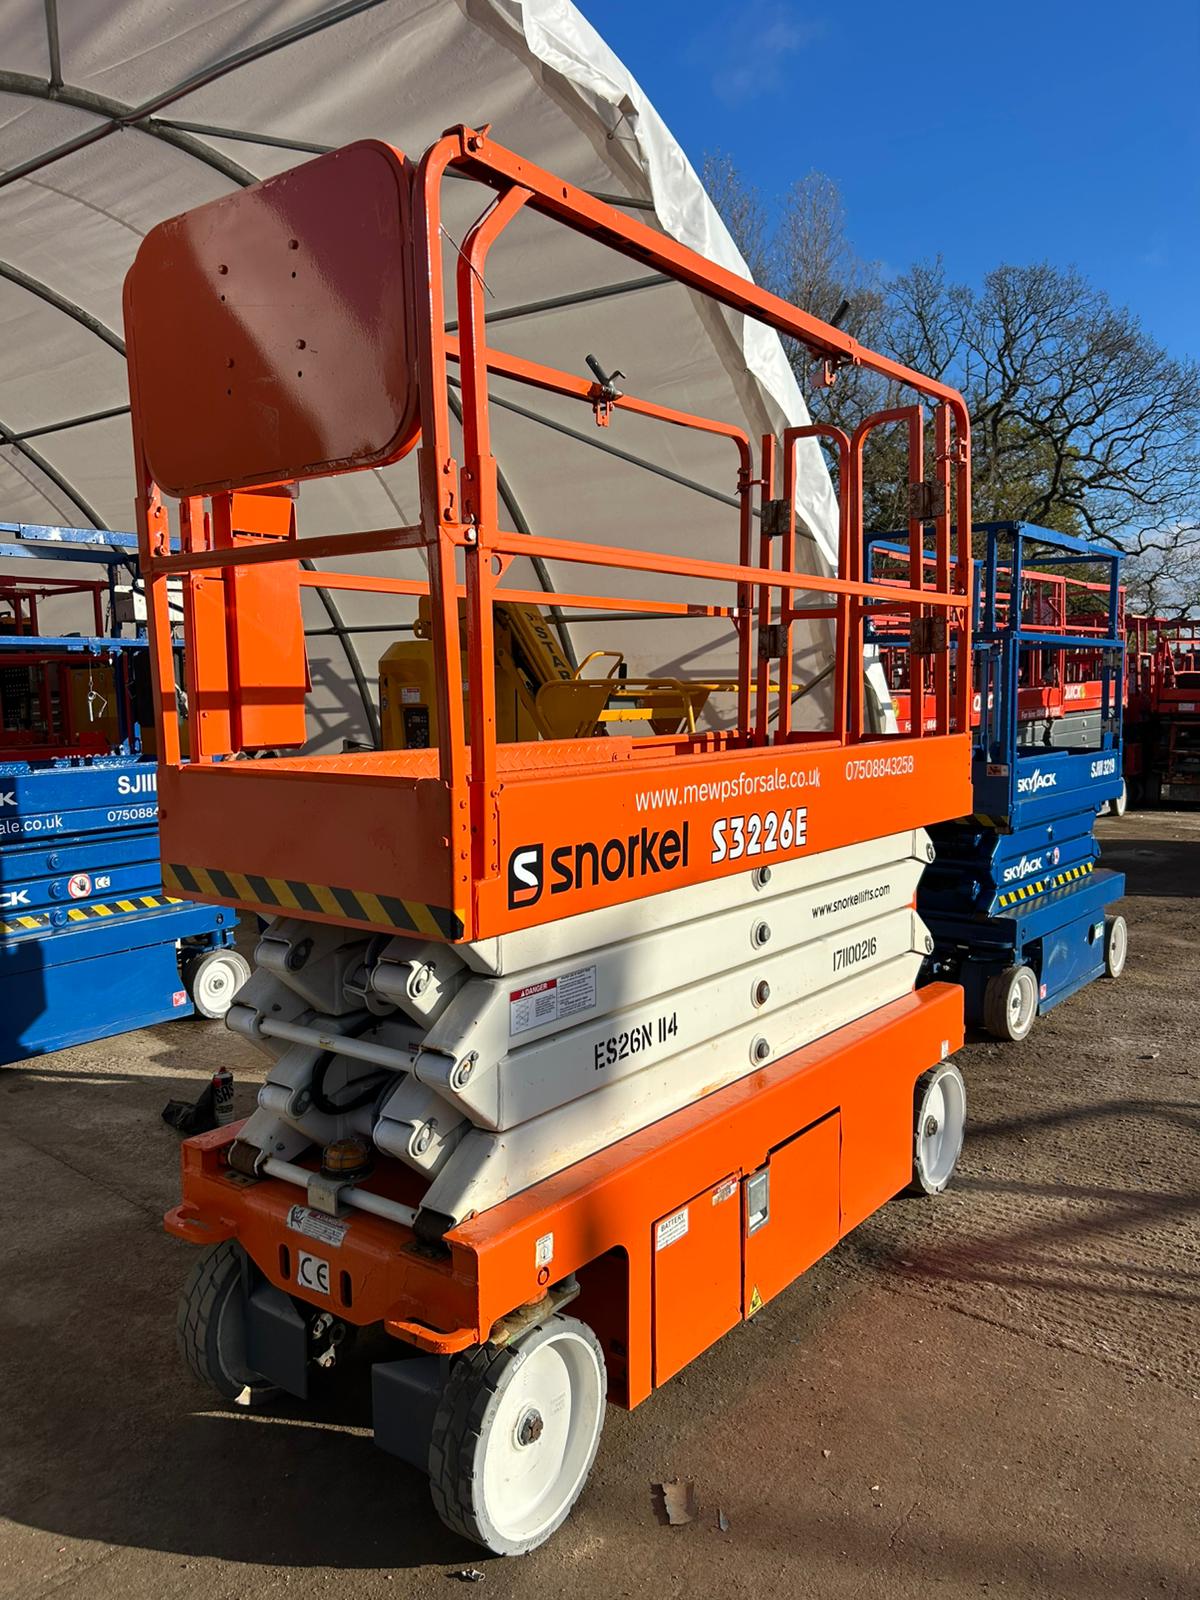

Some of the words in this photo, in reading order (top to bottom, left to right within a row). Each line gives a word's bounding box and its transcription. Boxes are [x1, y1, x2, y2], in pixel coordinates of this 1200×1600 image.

[635, 766, 821, 812] www.mewpsforsale.co.uk
[845, 755, 914, 782] 07508843258
[1017, 768, 1057, 792] SKYJACK
[550, 820, 689, 895] snorkel
[710, 806, 808, 864] S3226E
[1003, 855, 1043, 882] SKYJACK
[811, 884, 891, 919] www.snorkellifts.com
[594, 1022, 652, 1071] ES26N
[660, 1212, 685, 1232] BATTERY
[301, 1257, 329, 1291] CE
